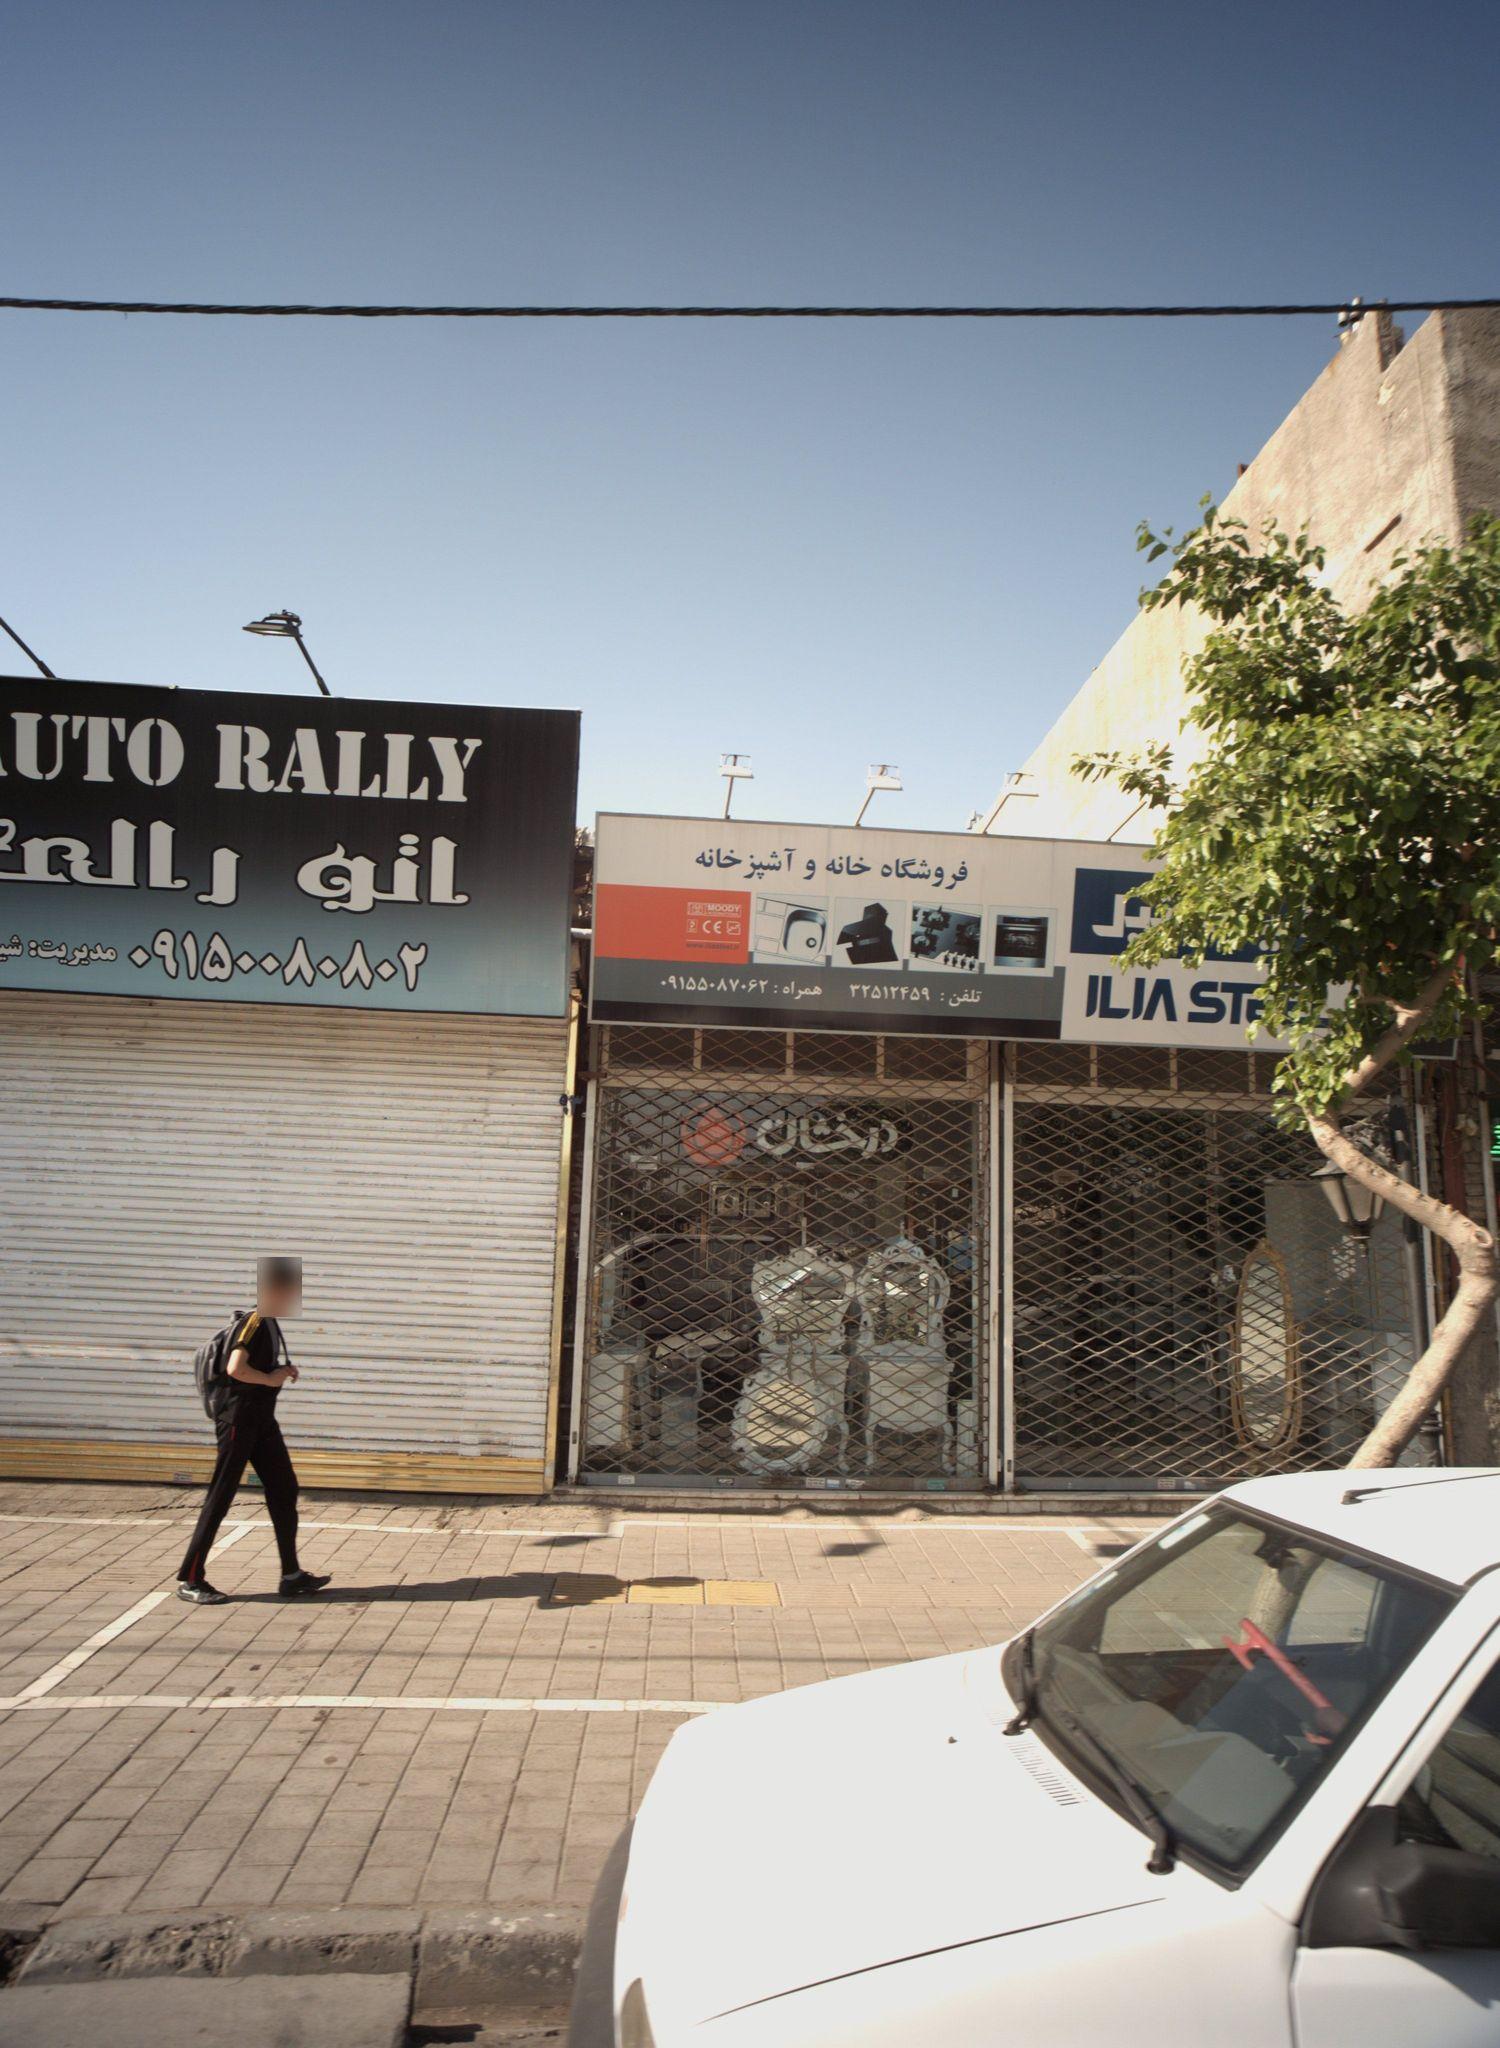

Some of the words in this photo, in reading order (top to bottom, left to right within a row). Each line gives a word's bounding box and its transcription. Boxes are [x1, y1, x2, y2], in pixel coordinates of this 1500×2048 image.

[0, 712, 185, 787] UTO
[214, 724, 483, 802] RALLY
[297, 833, 470, 912] اتو
[695, 848, 797, 880] آشپزخانه
[803, 858, 817, 880] و
[825, 855, 871, 876] خانه
[880, 859, 968, 889] فروشگاه
[128, 929, 428, 992] ۰۹۱۵۰۰۸۰۸۰۲
[660, 975, 769, 995] ۰۹۱۵۵۰۸۷۰۶۲
[849, 983, 930, 1001] ۳۲۵۱۲۴۵۹
